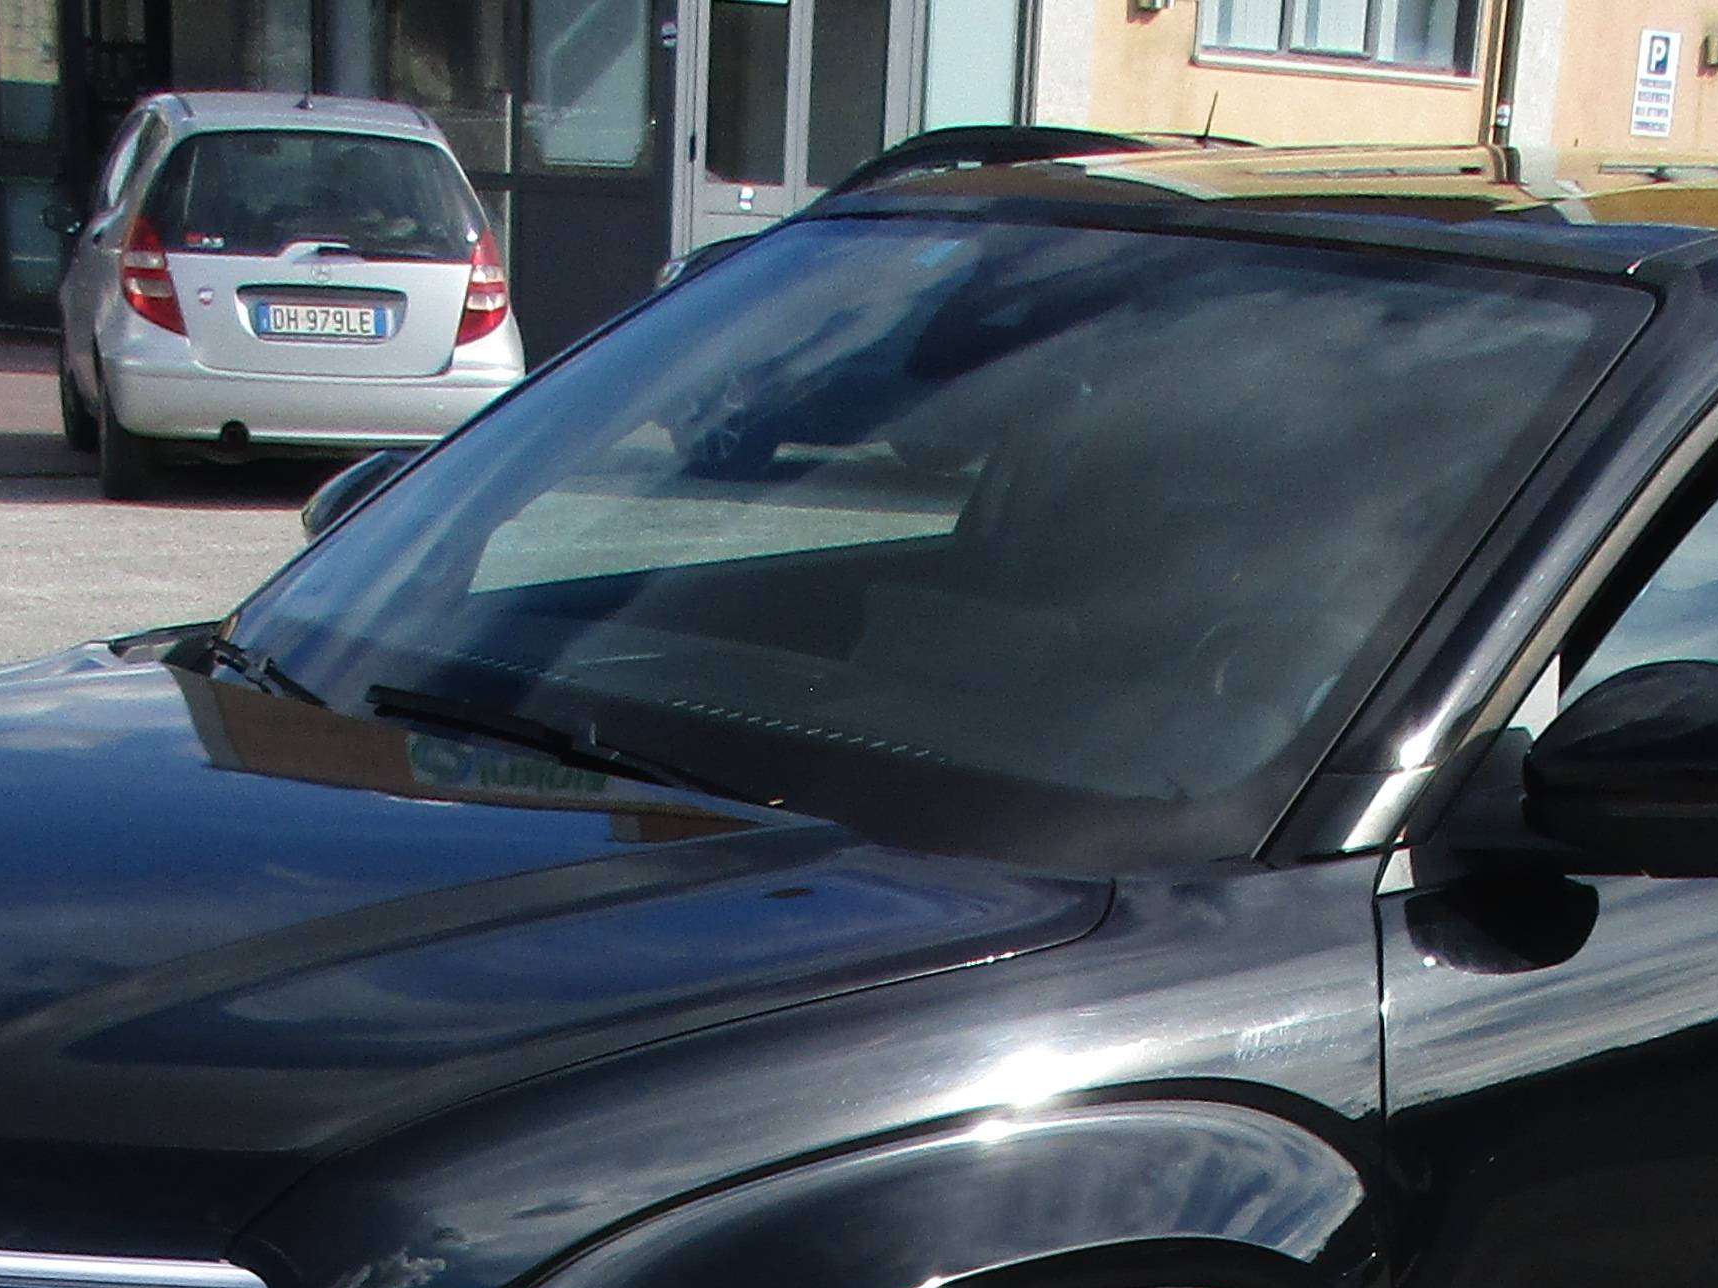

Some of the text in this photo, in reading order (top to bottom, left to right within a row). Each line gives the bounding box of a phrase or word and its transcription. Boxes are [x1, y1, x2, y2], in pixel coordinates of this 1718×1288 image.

[1650, 39, 1667, 72] P
[272, 307, 371, 334] DH 979LE
